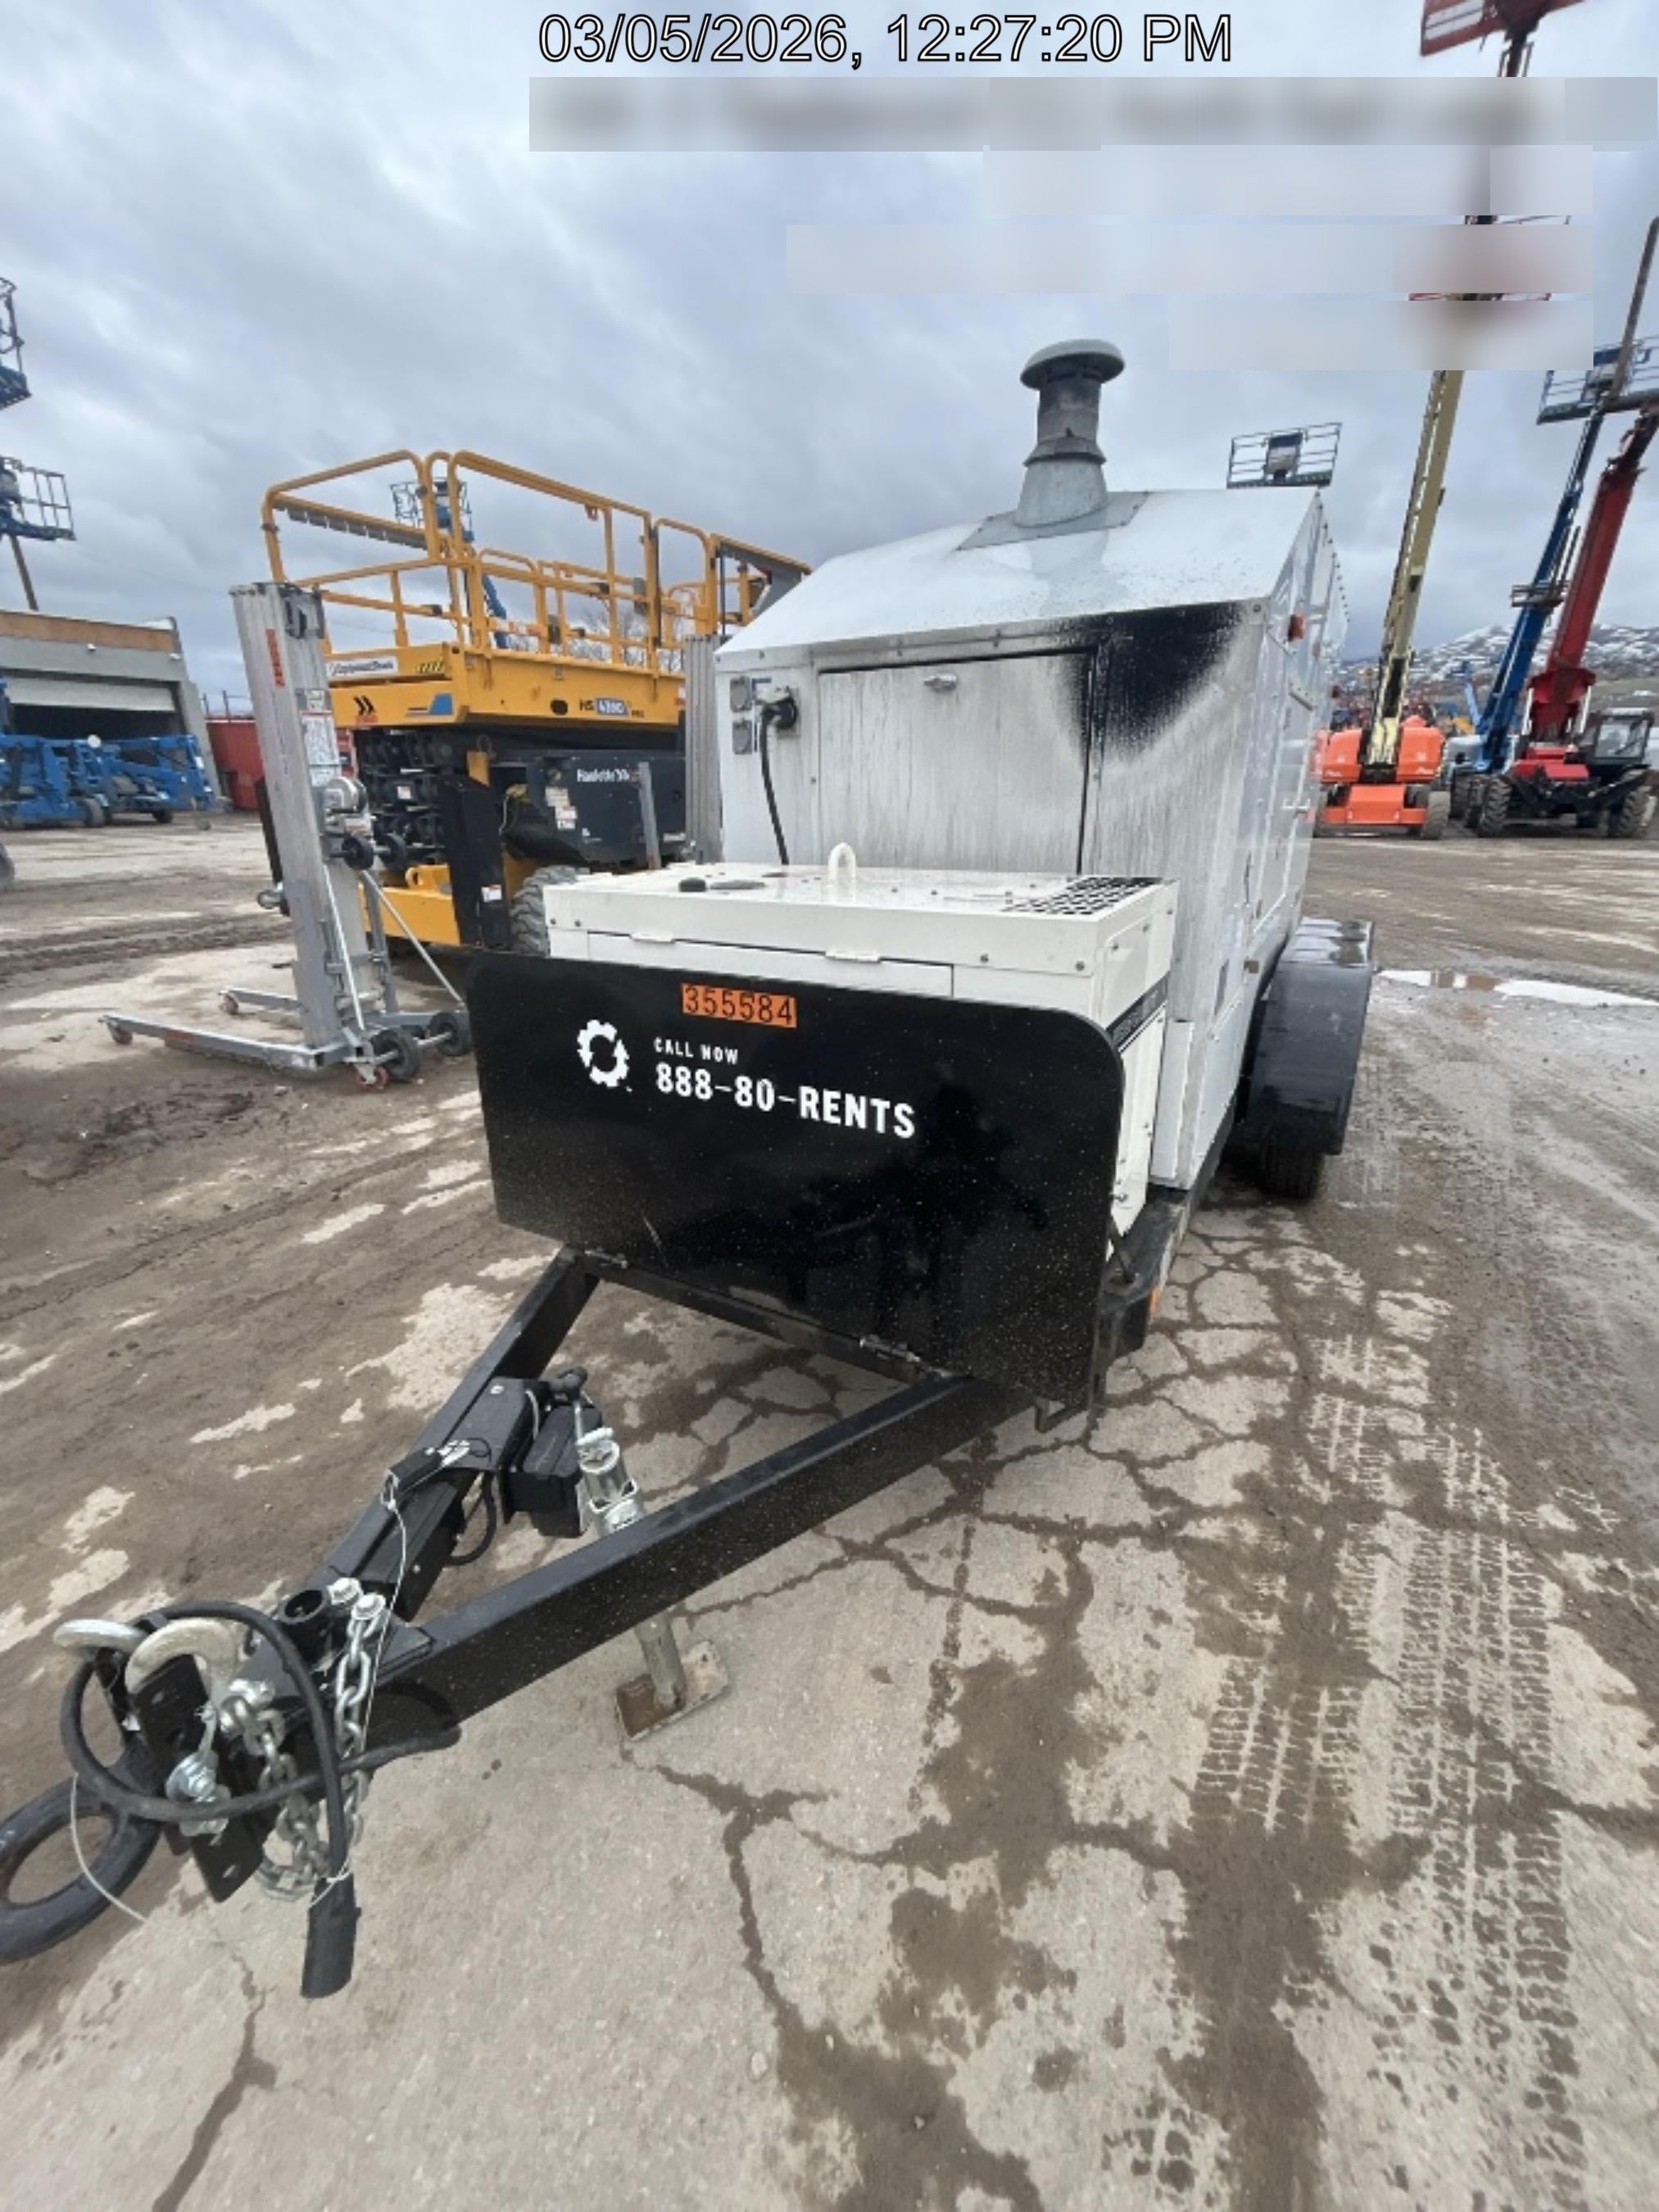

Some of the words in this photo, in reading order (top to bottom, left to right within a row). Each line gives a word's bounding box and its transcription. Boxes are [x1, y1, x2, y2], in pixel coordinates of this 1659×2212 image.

[684, 986, 793, 1026] 355584
[655, 1036, 694, 1058] CALL
[701, 1044, 738, 1064] NOW
[656, 1062, 916, 1140] 888-80-RENTS
